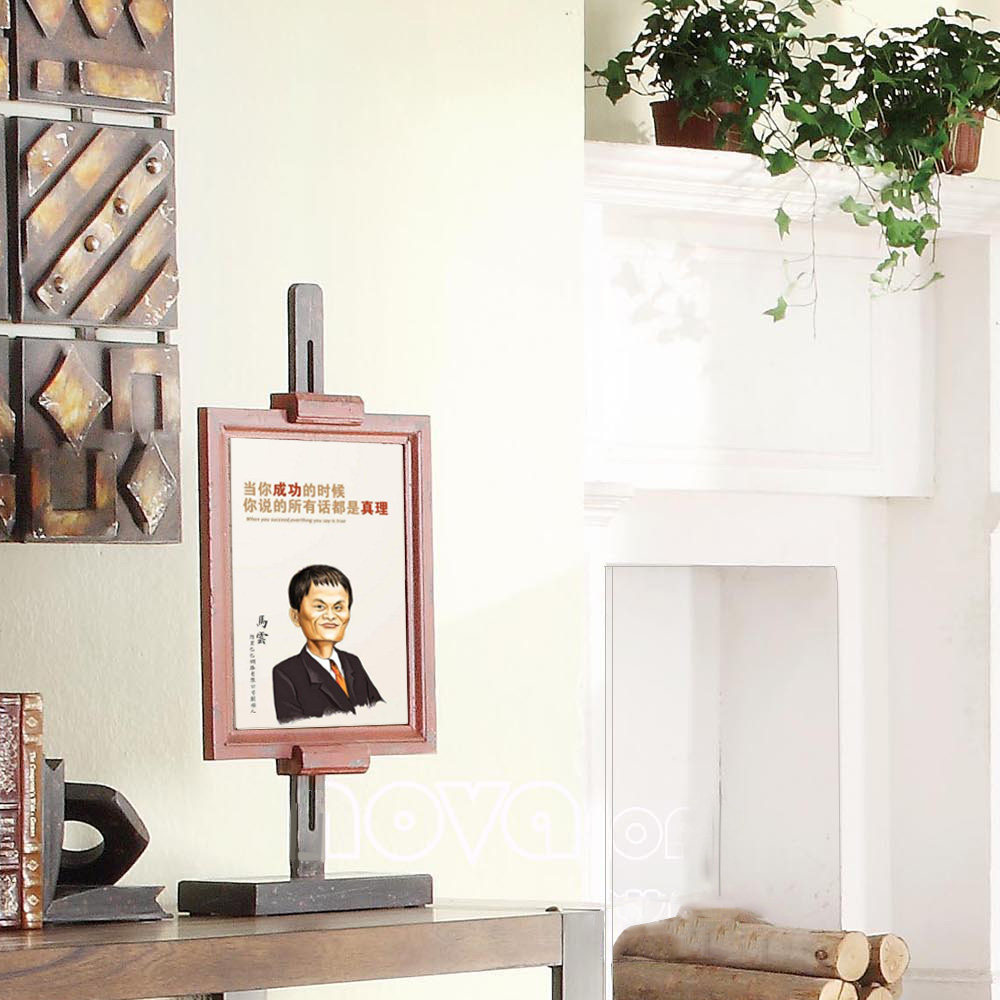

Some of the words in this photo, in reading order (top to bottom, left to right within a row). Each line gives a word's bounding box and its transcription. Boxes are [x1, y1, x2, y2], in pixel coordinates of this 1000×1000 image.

[243, 481, 346, 498] 当你成功的时候
[243, 498, 389, 516] 你说的所有话都是真理
